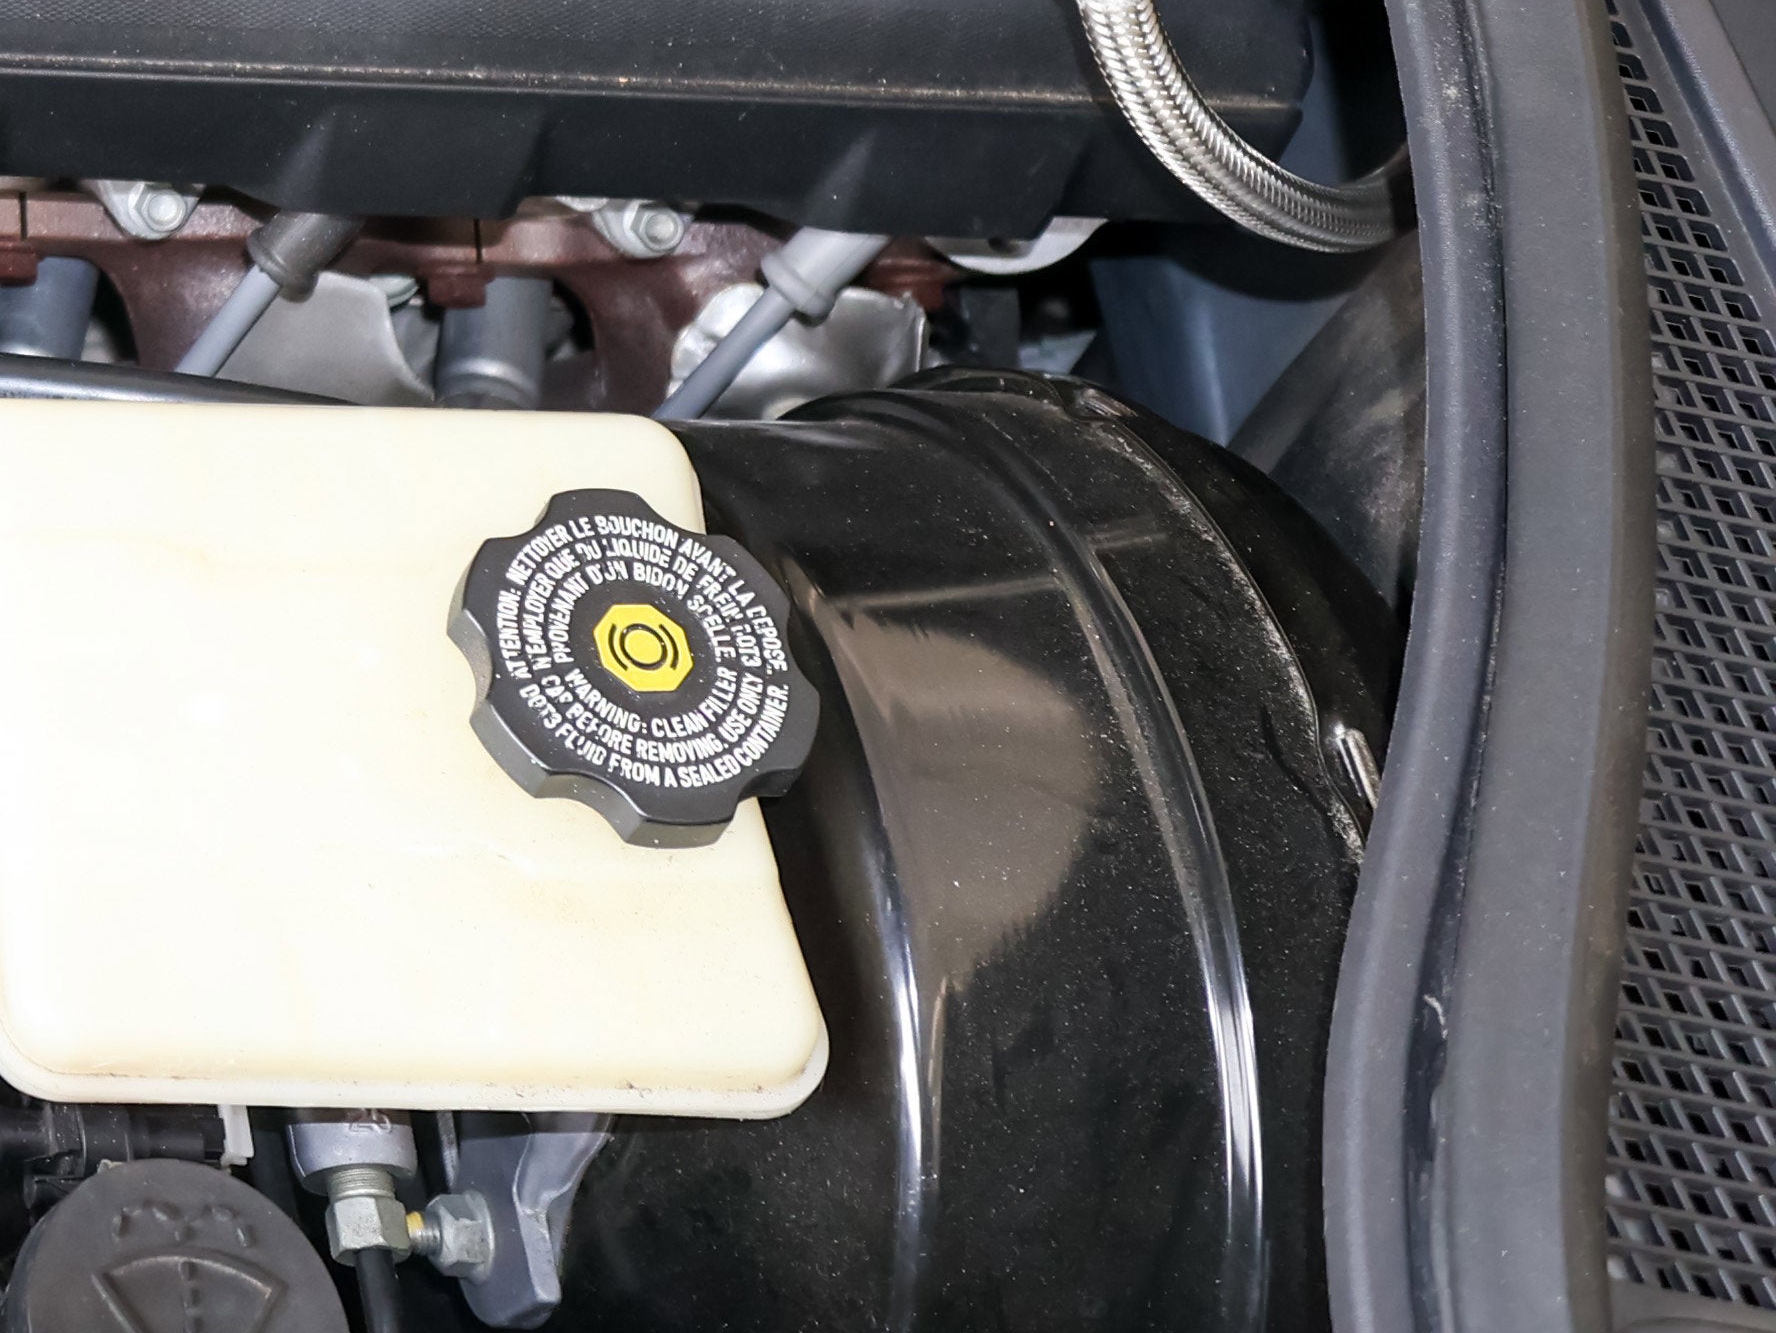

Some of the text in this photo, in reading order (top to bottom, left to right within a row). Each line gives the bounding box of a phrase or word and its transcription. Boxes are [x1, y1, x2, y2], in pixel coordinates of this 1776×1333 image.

[505, 524, 574, 586] NETTOYER
[570, 517, 592, 538] LE
[596, 515, 679, 549] BOUCHON
[679, 538, 737, 584] AVANT
[545, 552, 580, 580] QUE
[606, 541, 673, 565] LIQUIDE
[672, 556, 699, 578] DE
[696, 574, 741, 629] FREIN
[732, 619, 762, 668] DOT3
[547, 575, 591, 664] PROVENANT
[591, 560, 629, 585] D'UN
[633, 563, 689, 599] BIDON
[728, 578, 759, 608] LA
[498, 588, 530, 680] ATTENTION:
[519, 683, 790, 788] DOT3 FLUID FROM A SEALED CONTAINER.
[540, 674, 764, 764] CAP BEFORE REMOVING. USE ONLY
[564, 668, 738, 738] WARNING: CLEAN FILLER
